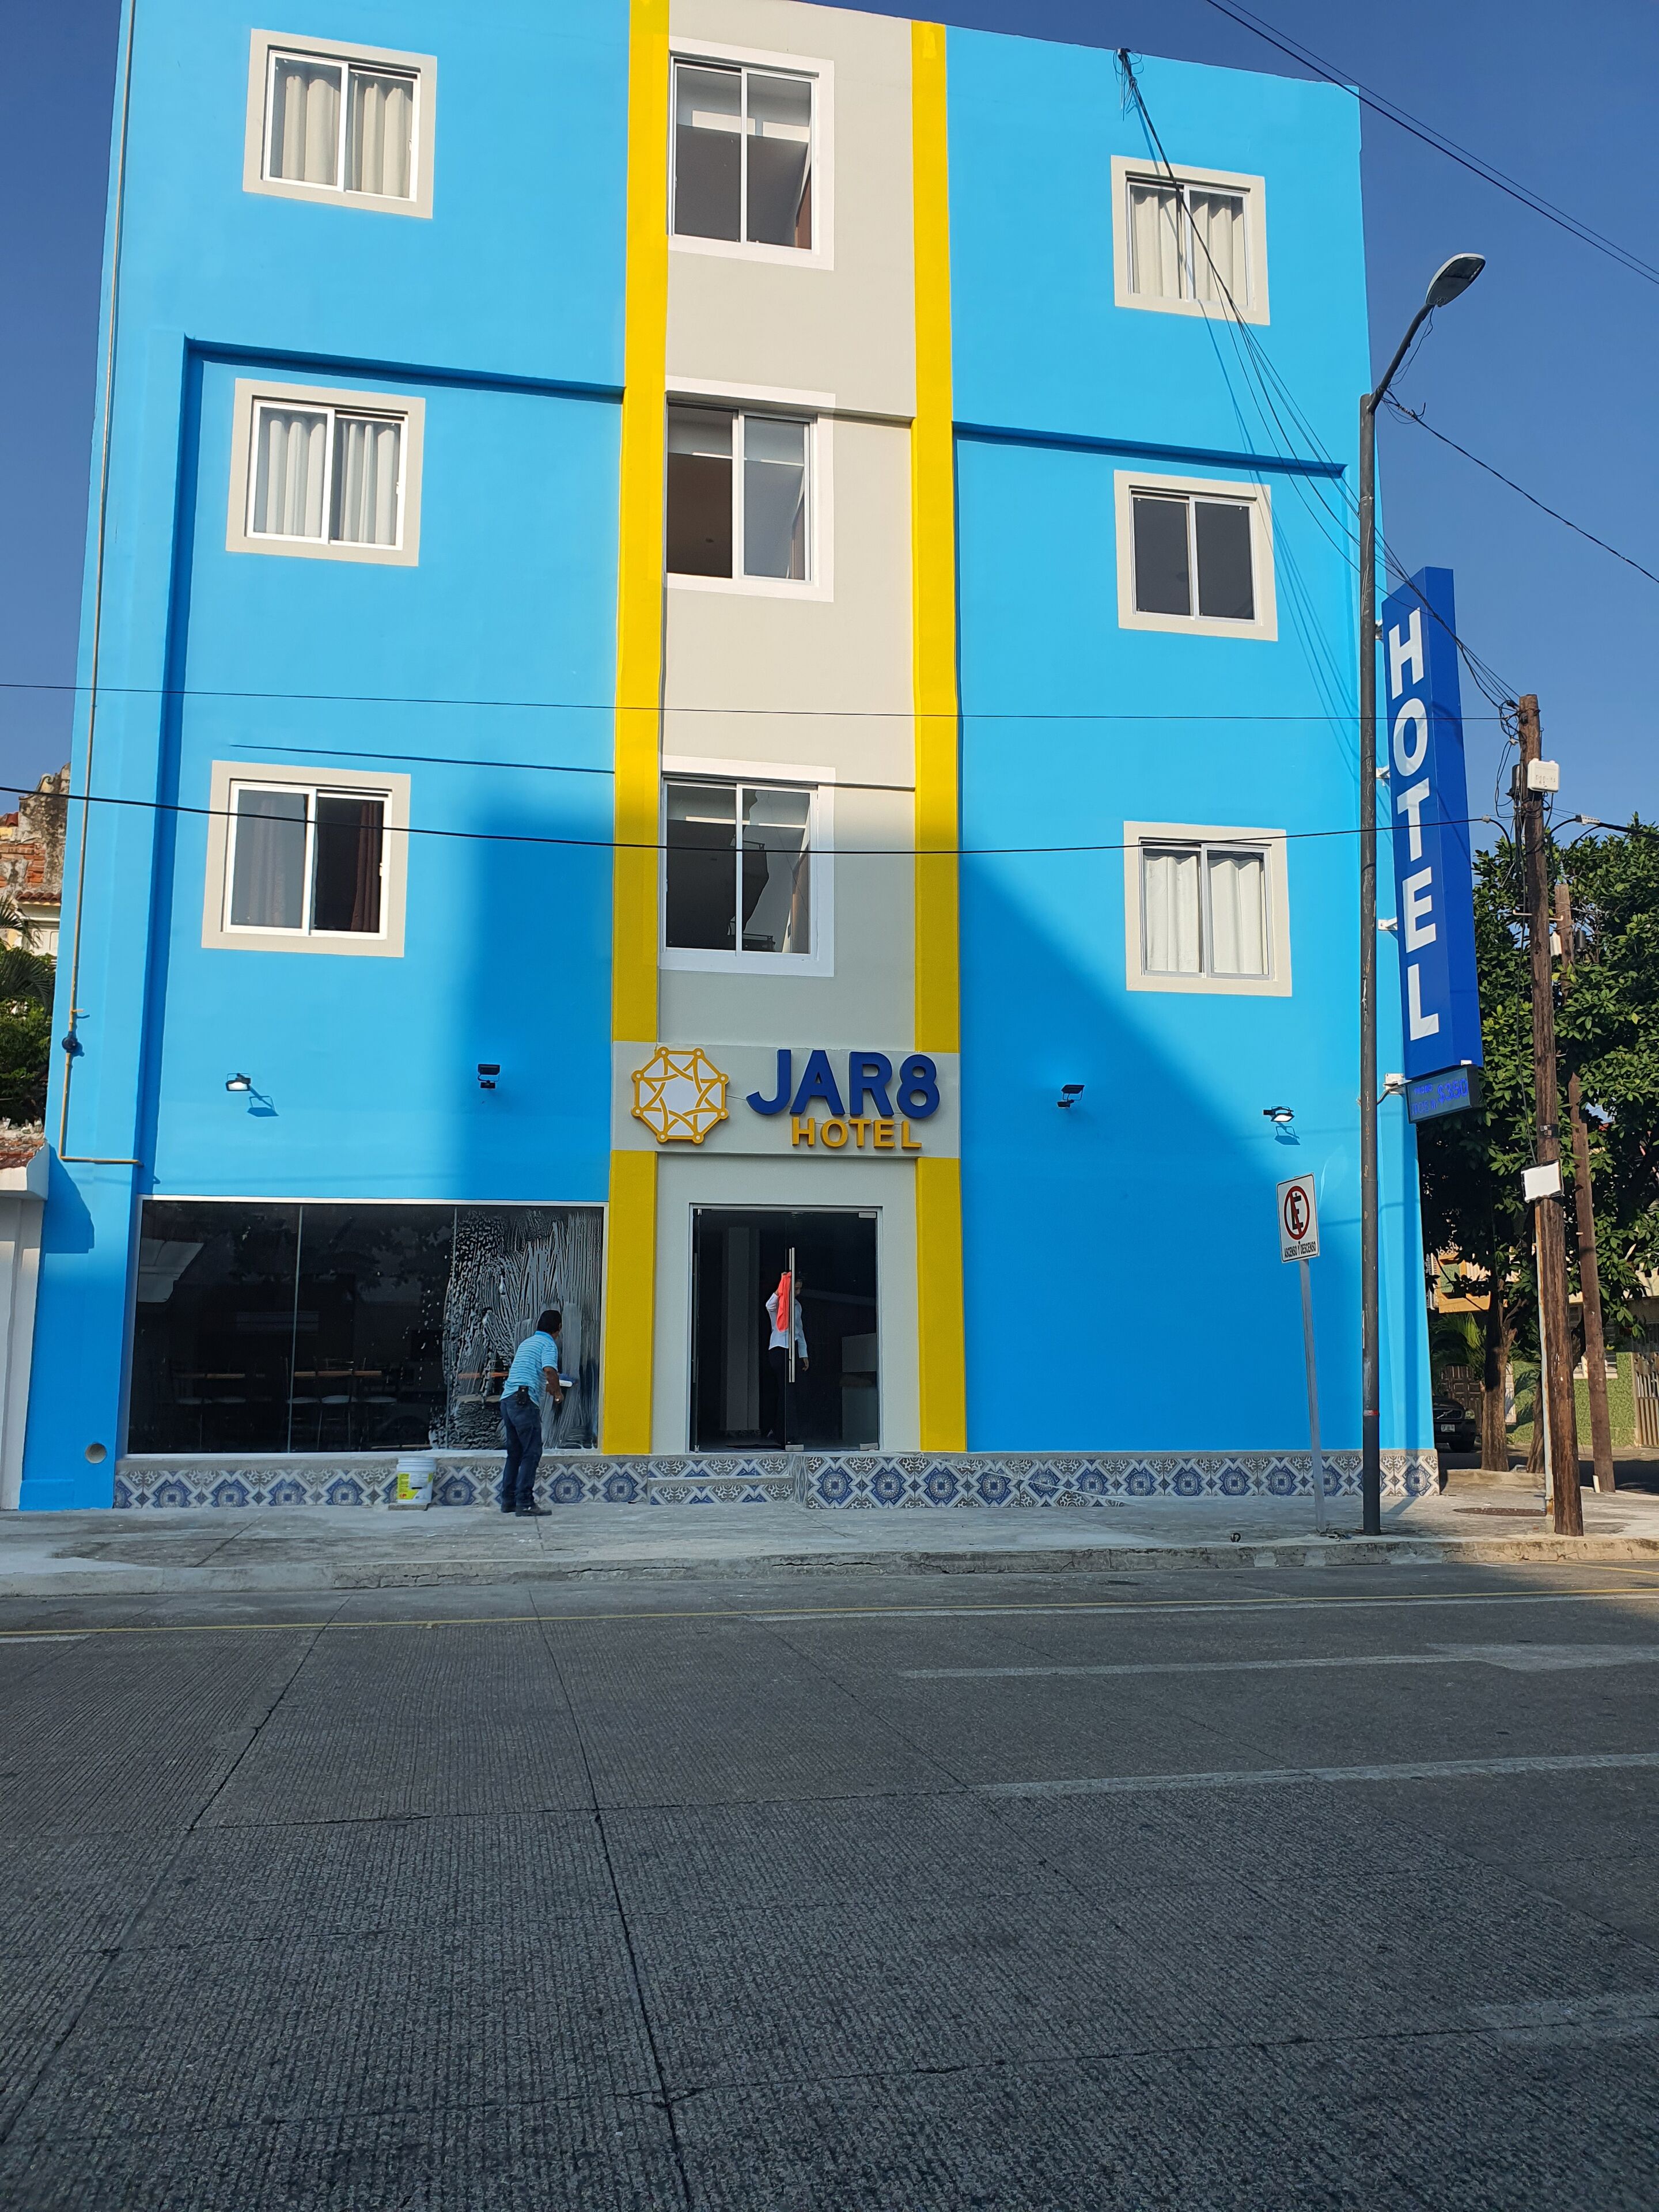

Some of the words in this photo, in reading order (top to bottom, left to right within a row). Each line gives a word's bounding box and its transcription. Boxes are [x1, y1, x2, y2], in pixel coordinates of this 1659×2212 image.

[1389, 607, 1440, 1041] HOTEL
[746, 1050, 940, 1118] JAR8
[1438, 1078, 1468, 1104] $350
[791, 1118, 922, 1149] HOTEL
[1290, 1195, 1304, 1230] E
[1300, 1241, 1316, 1255] DESCENSO
